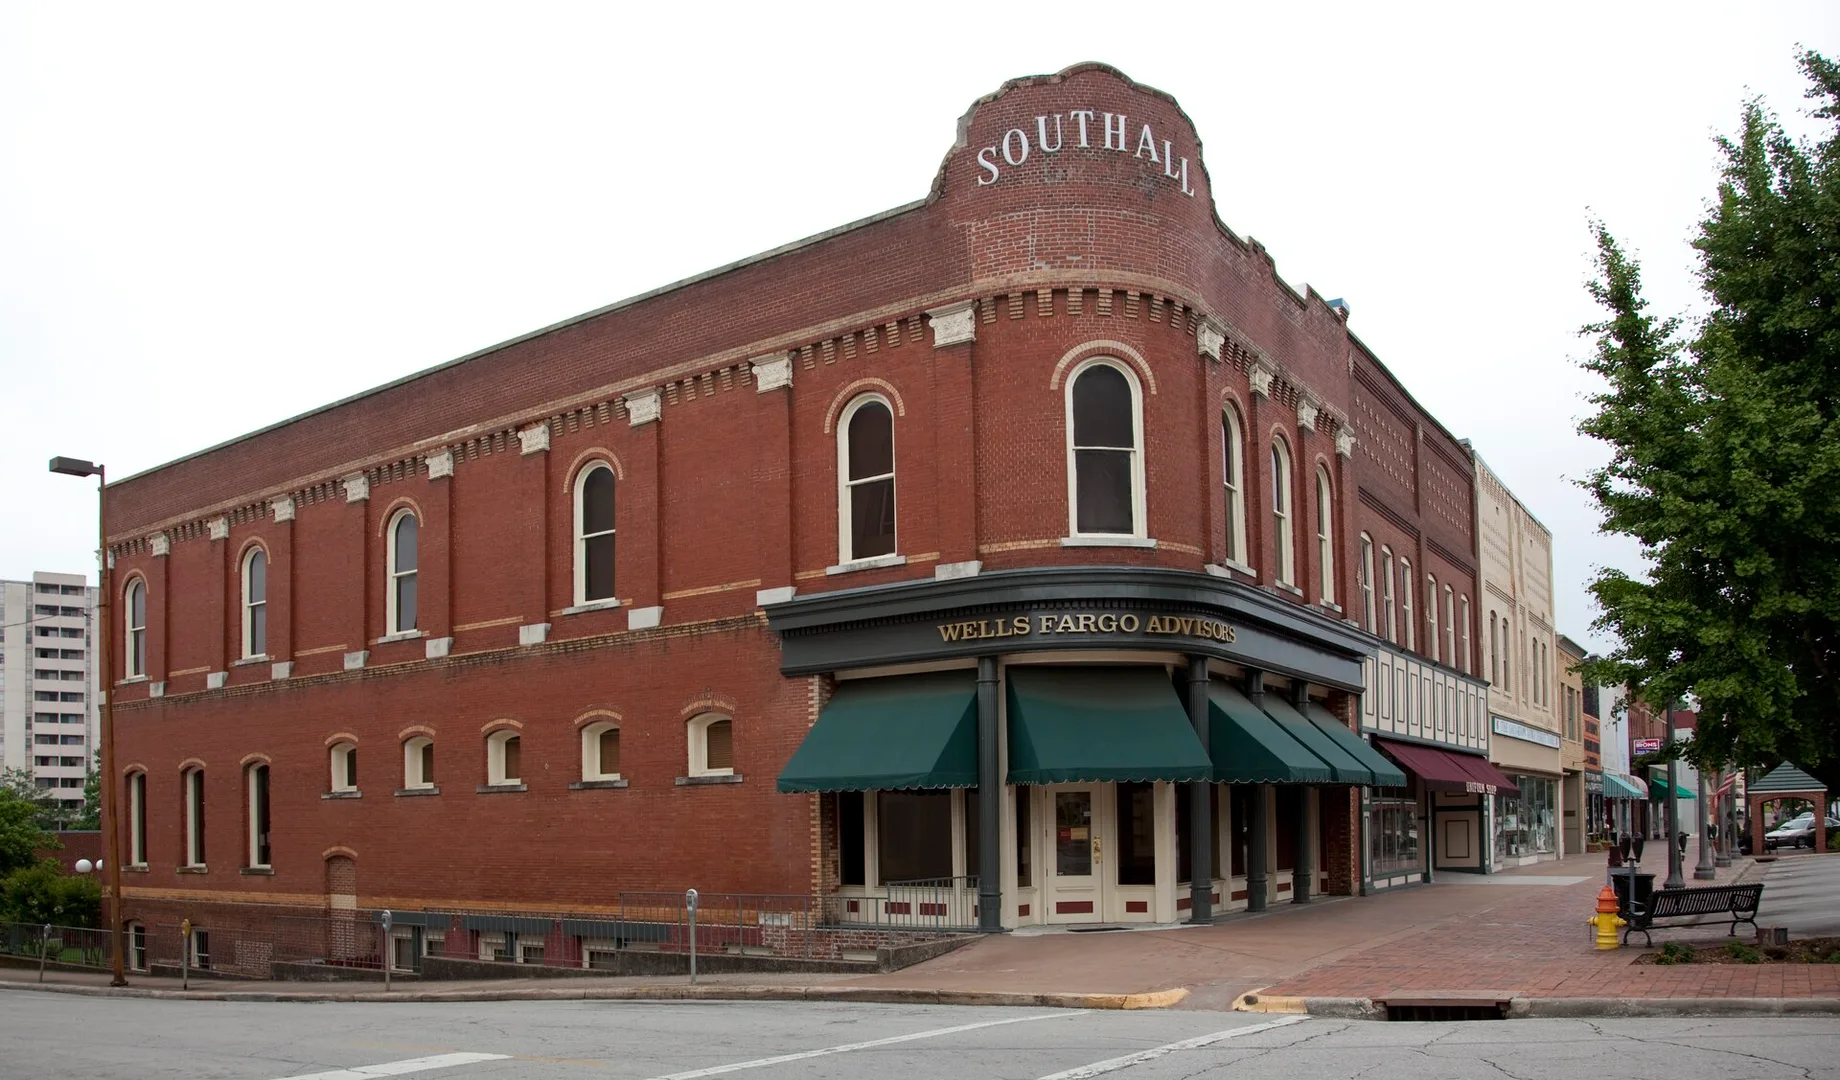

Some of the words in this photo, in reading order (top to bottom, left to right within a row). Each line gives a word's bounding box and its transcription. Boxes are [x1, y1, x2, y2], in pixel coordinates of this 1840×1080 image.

[977, 110, 1195, 198] SOUTHALL
[937, 616, 1031, 642] WELLS
[1038, 613, 1140, 634] FARGO
[1144, 614, 1237, 643] ADVISORS
